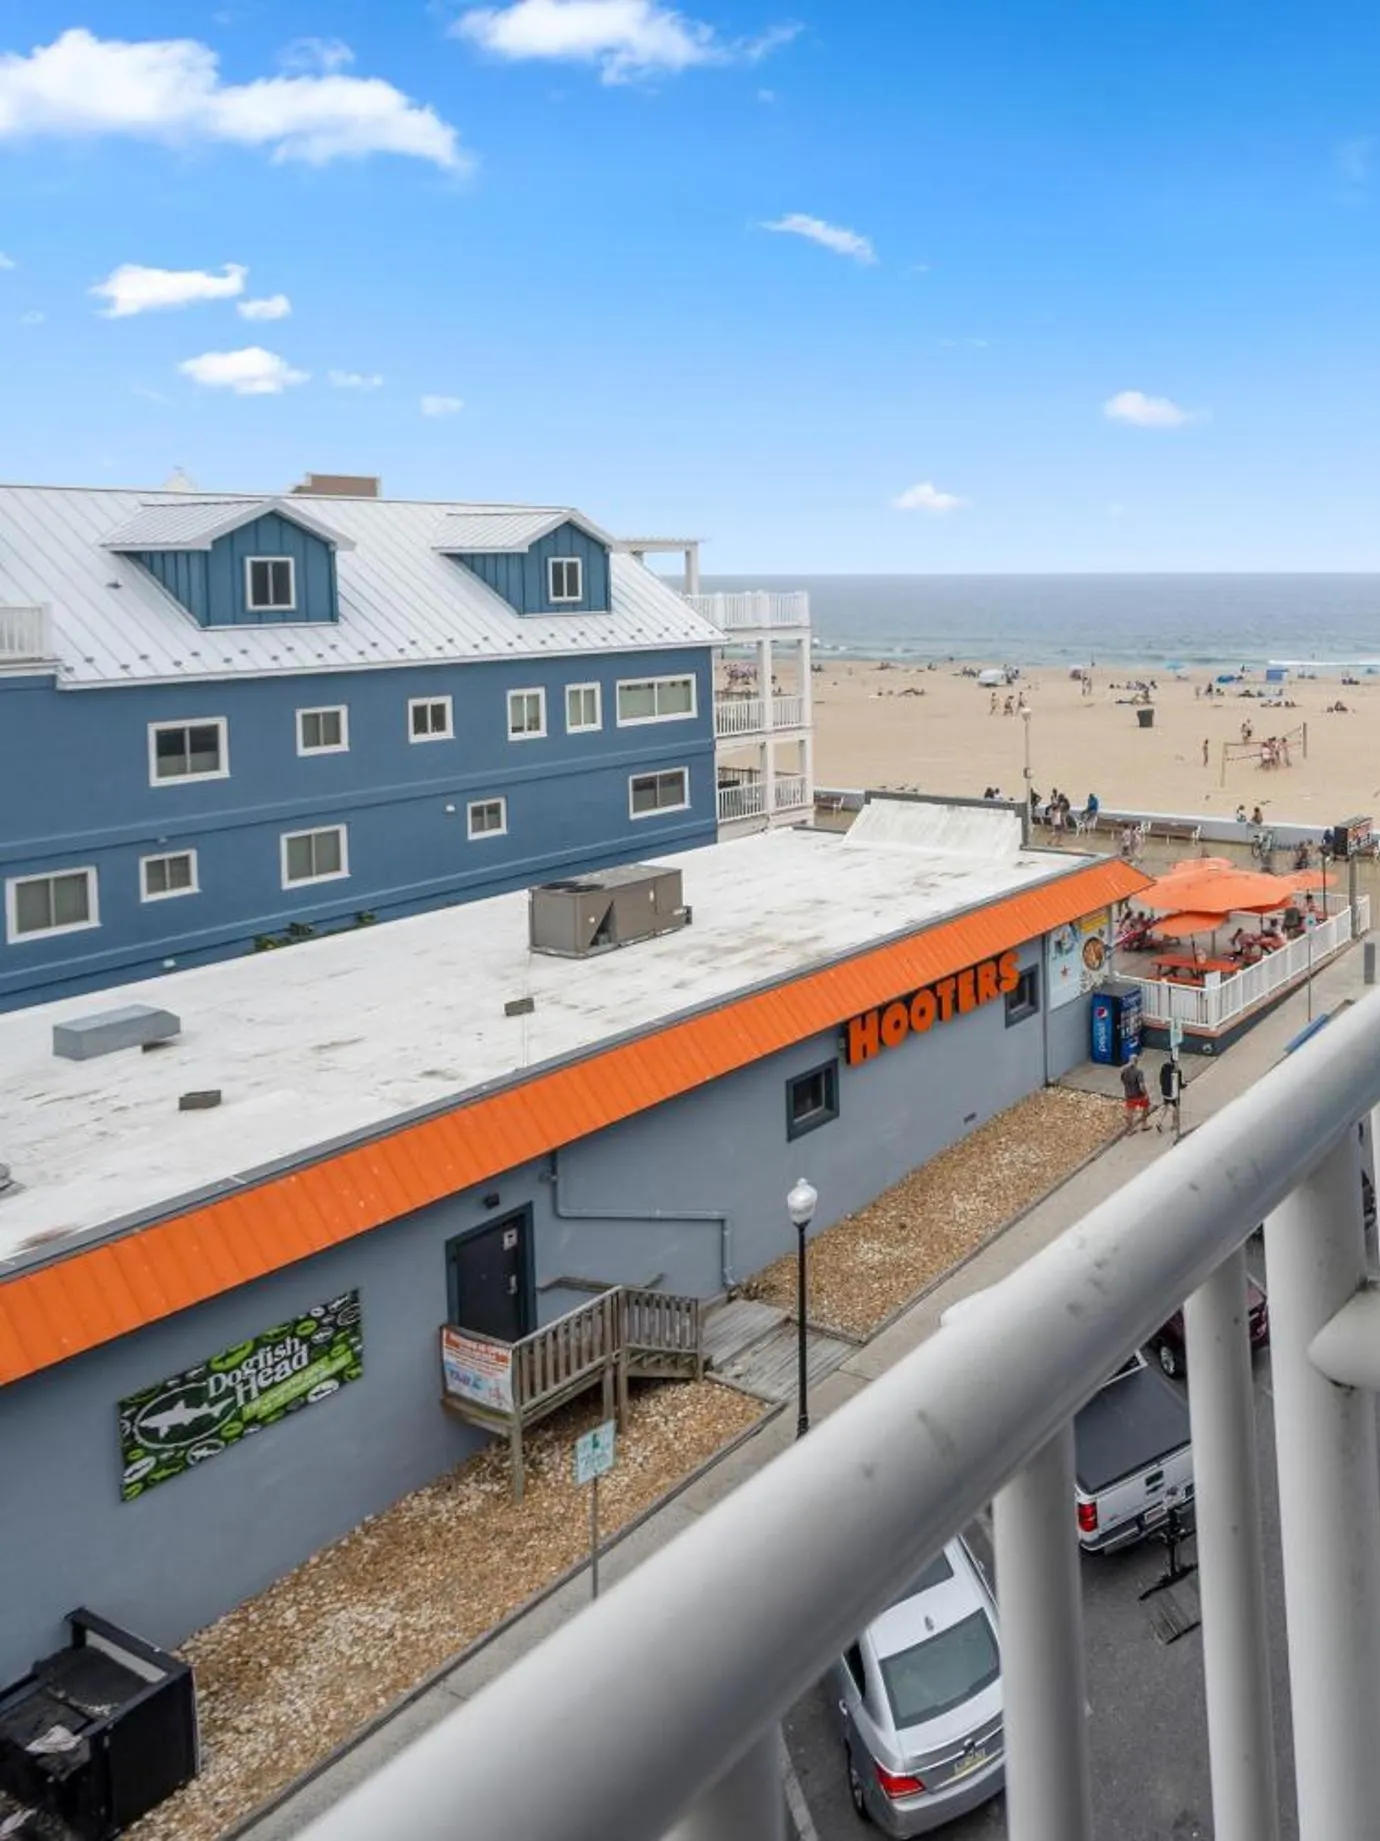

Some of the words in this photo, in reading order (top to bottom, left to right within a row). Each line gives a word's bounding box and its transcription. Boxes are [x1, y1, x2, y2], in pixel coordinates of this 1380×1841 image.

[848, 951, 1020, 1066] HOOTERS
[209, 1336, 301, 1398] Dogfish
[236, 1344, 309, 1407] Head
